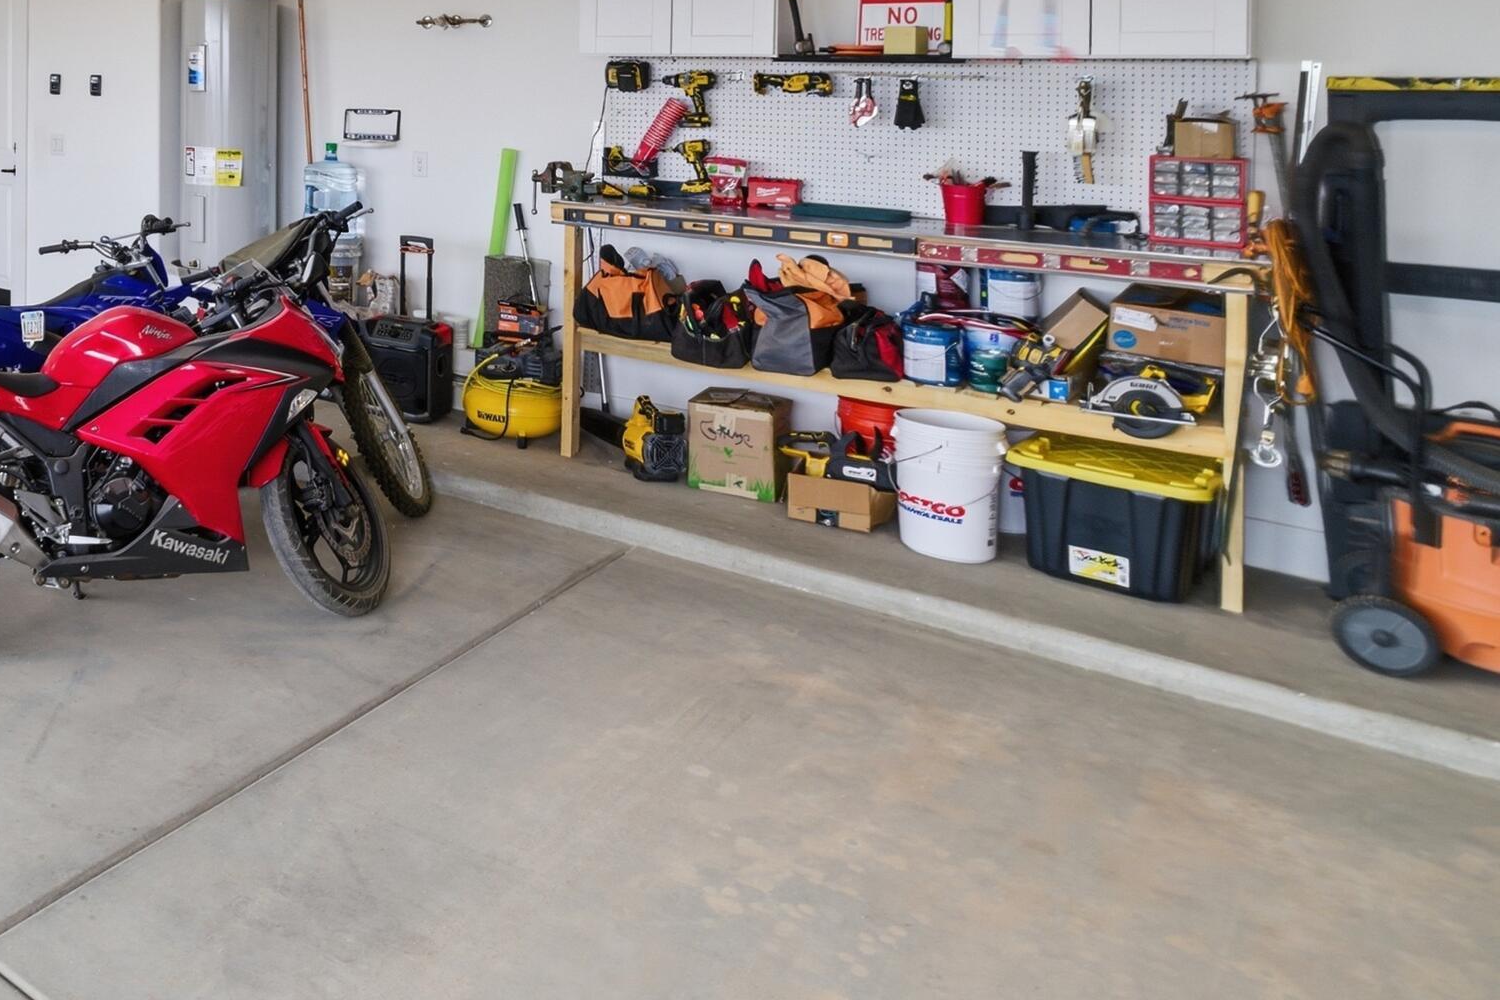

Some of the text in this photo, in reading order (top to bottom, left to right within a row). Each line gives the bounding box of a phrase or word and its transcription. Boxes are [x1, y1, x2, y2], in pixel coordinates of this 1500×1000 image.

[887, 6, 918, 24] NO
[141, 324, 171, 341] Ninja
[150, 529, 231, 565] Kawasaki
